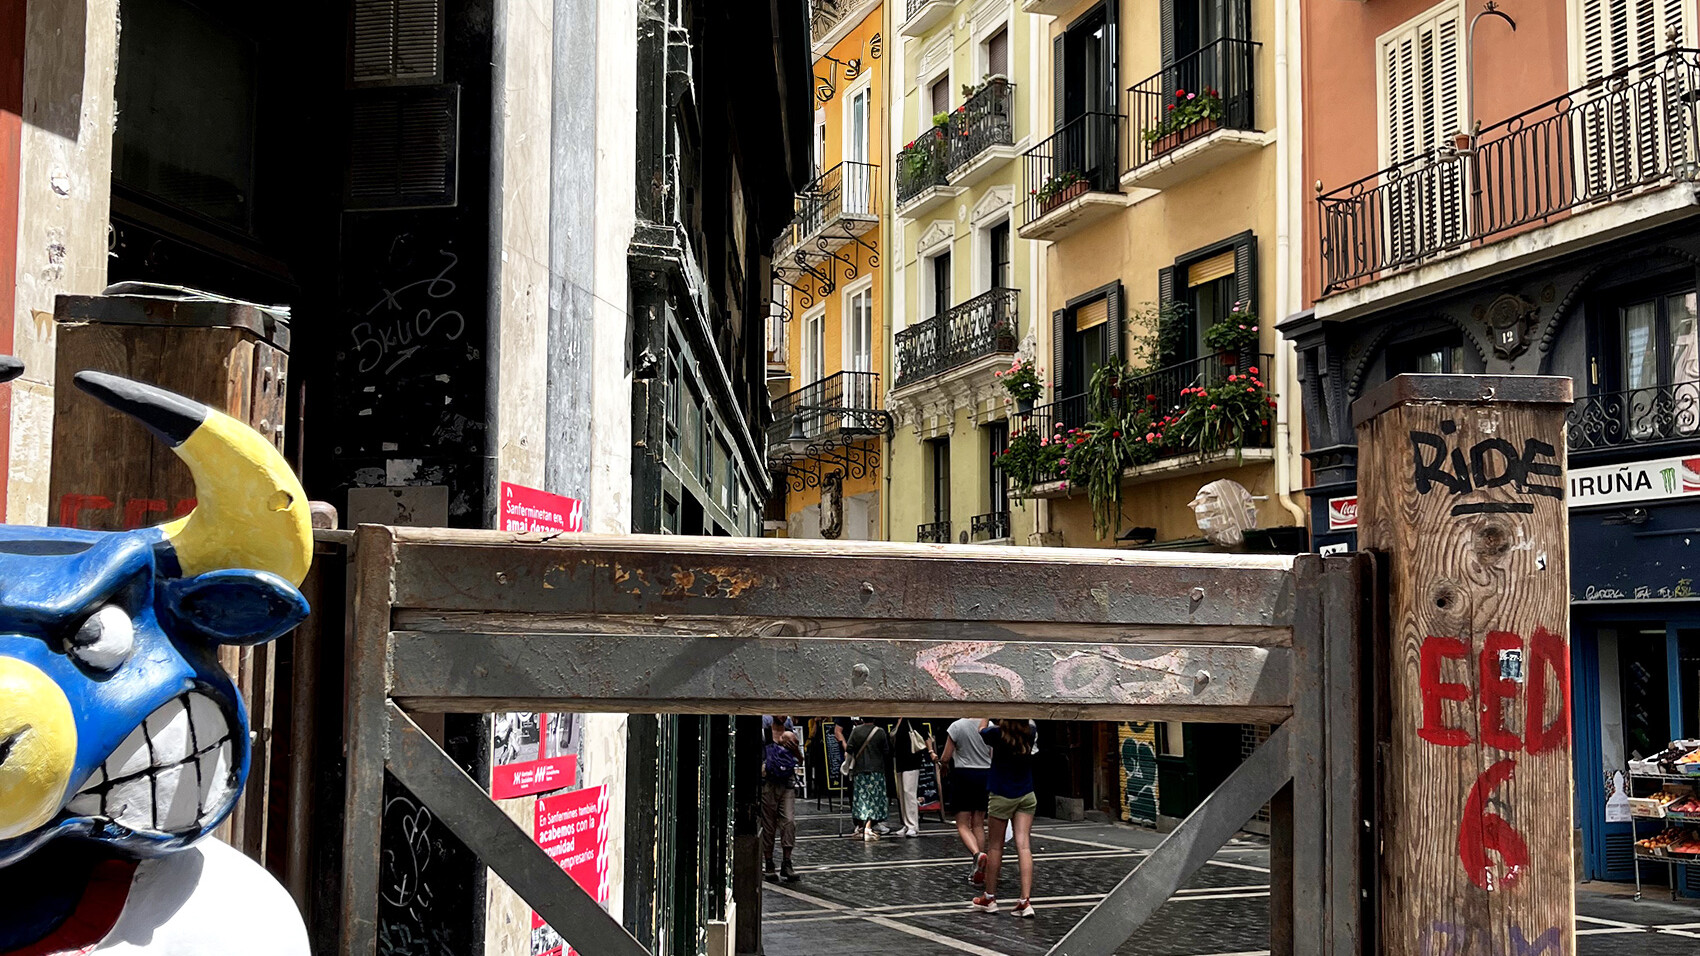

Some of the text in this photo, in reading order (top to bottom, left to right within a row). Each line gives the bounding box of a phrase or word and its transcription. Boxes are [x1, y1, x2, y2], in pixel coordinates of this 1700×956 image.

[1502, 331, 1513, 344] 12
[1571, 466, 1653, 497] IRUÑA
[506, 500, 552, 521] Sanferminetan
[506, 518, 528, 532] amai
[539, 815, 547, 827] En
[547, 808, 578, 825] Sanfermines
[539, 814, 595, 843] acabemos con la
[560, 848, 594, 870] empresarios
